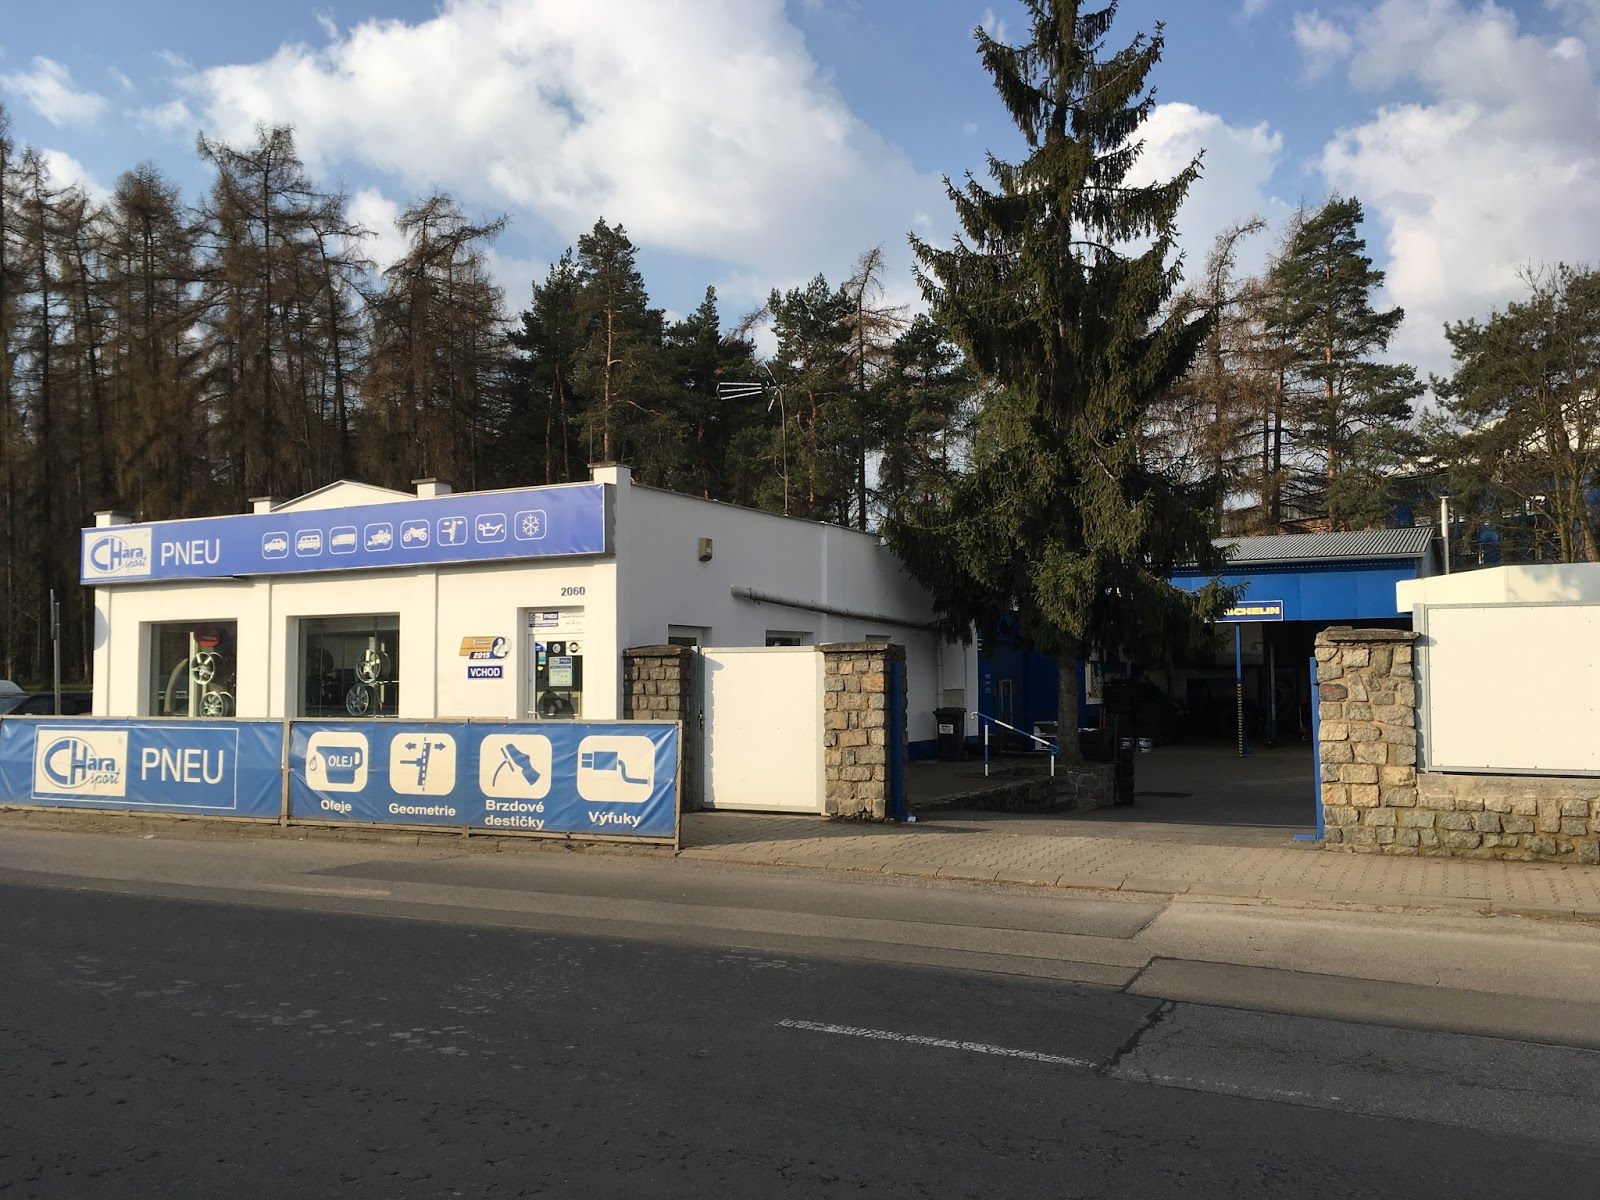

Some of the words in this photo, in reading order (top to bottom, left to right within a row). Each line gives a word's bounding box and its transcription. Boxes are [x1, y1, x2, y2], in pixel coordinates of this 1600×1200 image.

[161, 538, 220, 566] PNEU
[561, 586, 586, 597] 2060
[470, 667, 501, 677] VCHOD
[141, 747, 224, 785] PNEU
[328, 755, 353, 767] OLEJ
[320, 799, 352, 814] Oleje
[388, 803, 457, 817] Geometrie
[485, 799, 545, 813] Brzdové
[485, 815, 545, 831] destičky
[588, 811, 642, 828] Výfuky
